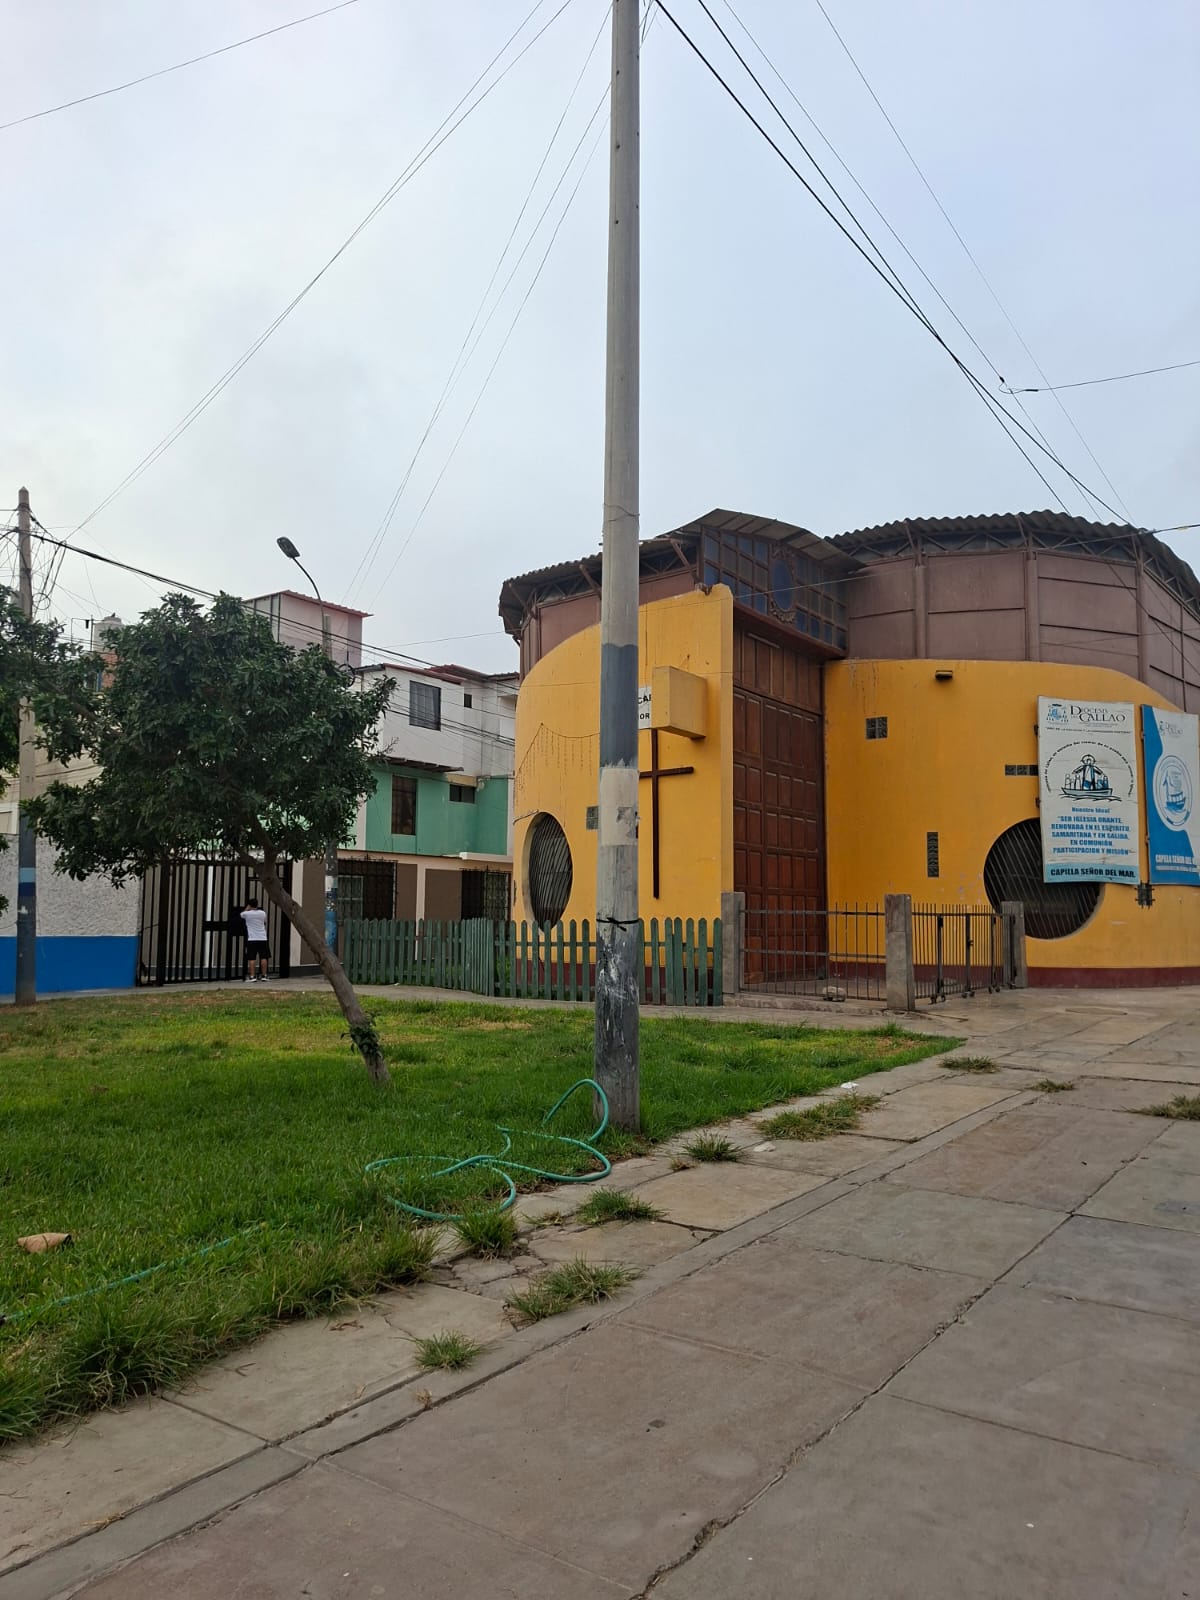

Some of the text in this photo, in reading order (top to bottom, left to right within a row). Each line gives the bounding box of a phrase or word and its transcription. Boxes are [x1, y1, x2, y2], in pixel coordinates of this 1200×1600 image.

[1079, 713, 1126, 722] CALLAO
[1050, 868, 1080, 876] CAPILLA
[1080, 867, 1104, 876] SEÑOR
[1105, 869, 1117, 877] DEL
